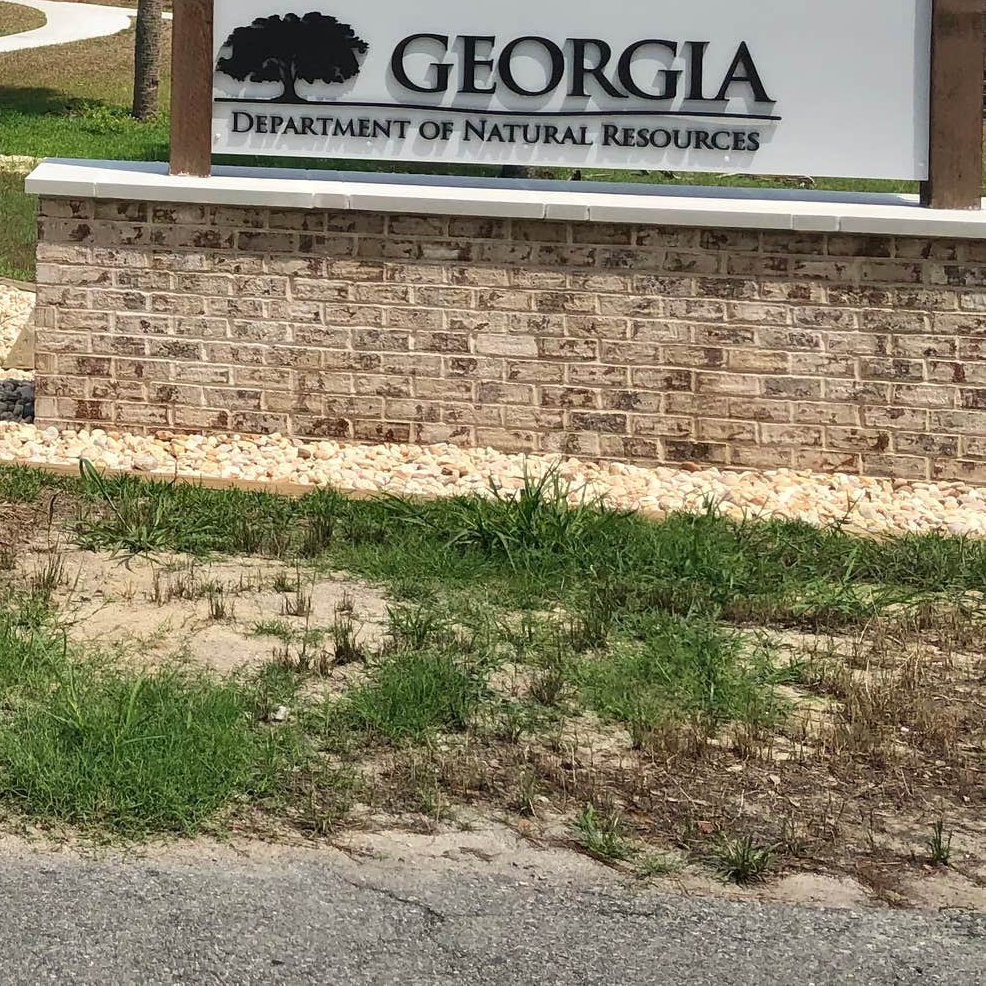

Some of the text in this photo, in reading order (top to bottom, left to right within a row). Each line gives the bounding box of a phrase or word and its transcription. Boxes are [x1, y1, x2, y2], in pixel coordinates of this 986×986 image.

[390, 33, 777, 103] GEORGIA
[231, 111, 761, 152] DEPARTMENT OF NATURAL RESOURCES
